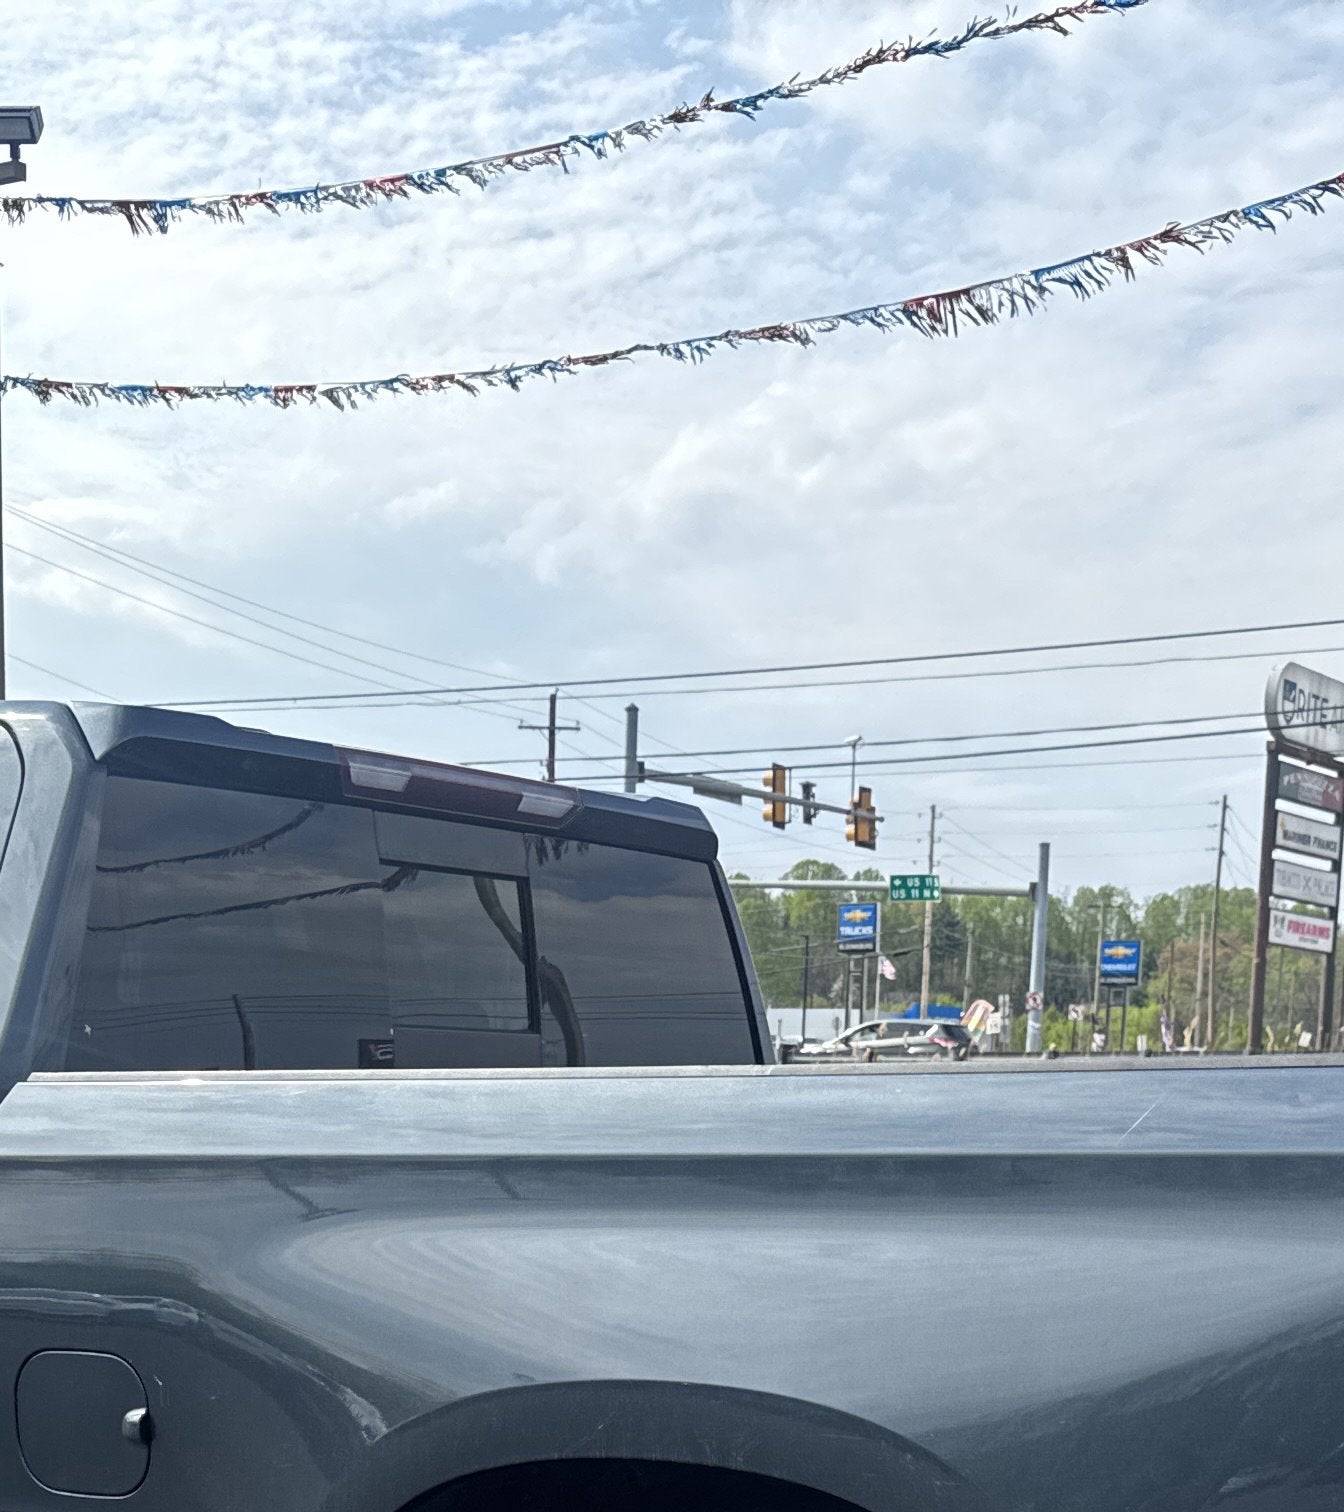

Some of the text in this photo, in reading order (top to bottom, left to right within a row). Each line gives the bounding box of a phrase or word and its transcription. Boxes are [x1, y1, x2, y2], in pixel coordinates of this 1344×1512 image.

[1297, 689, 1329, 730] RITE
[906, 878, 920, 887] US
[892, 888, 906, 898] US
[910, 888, 919, 898] 11
[839, 926, 874, 936] TRUCKS
